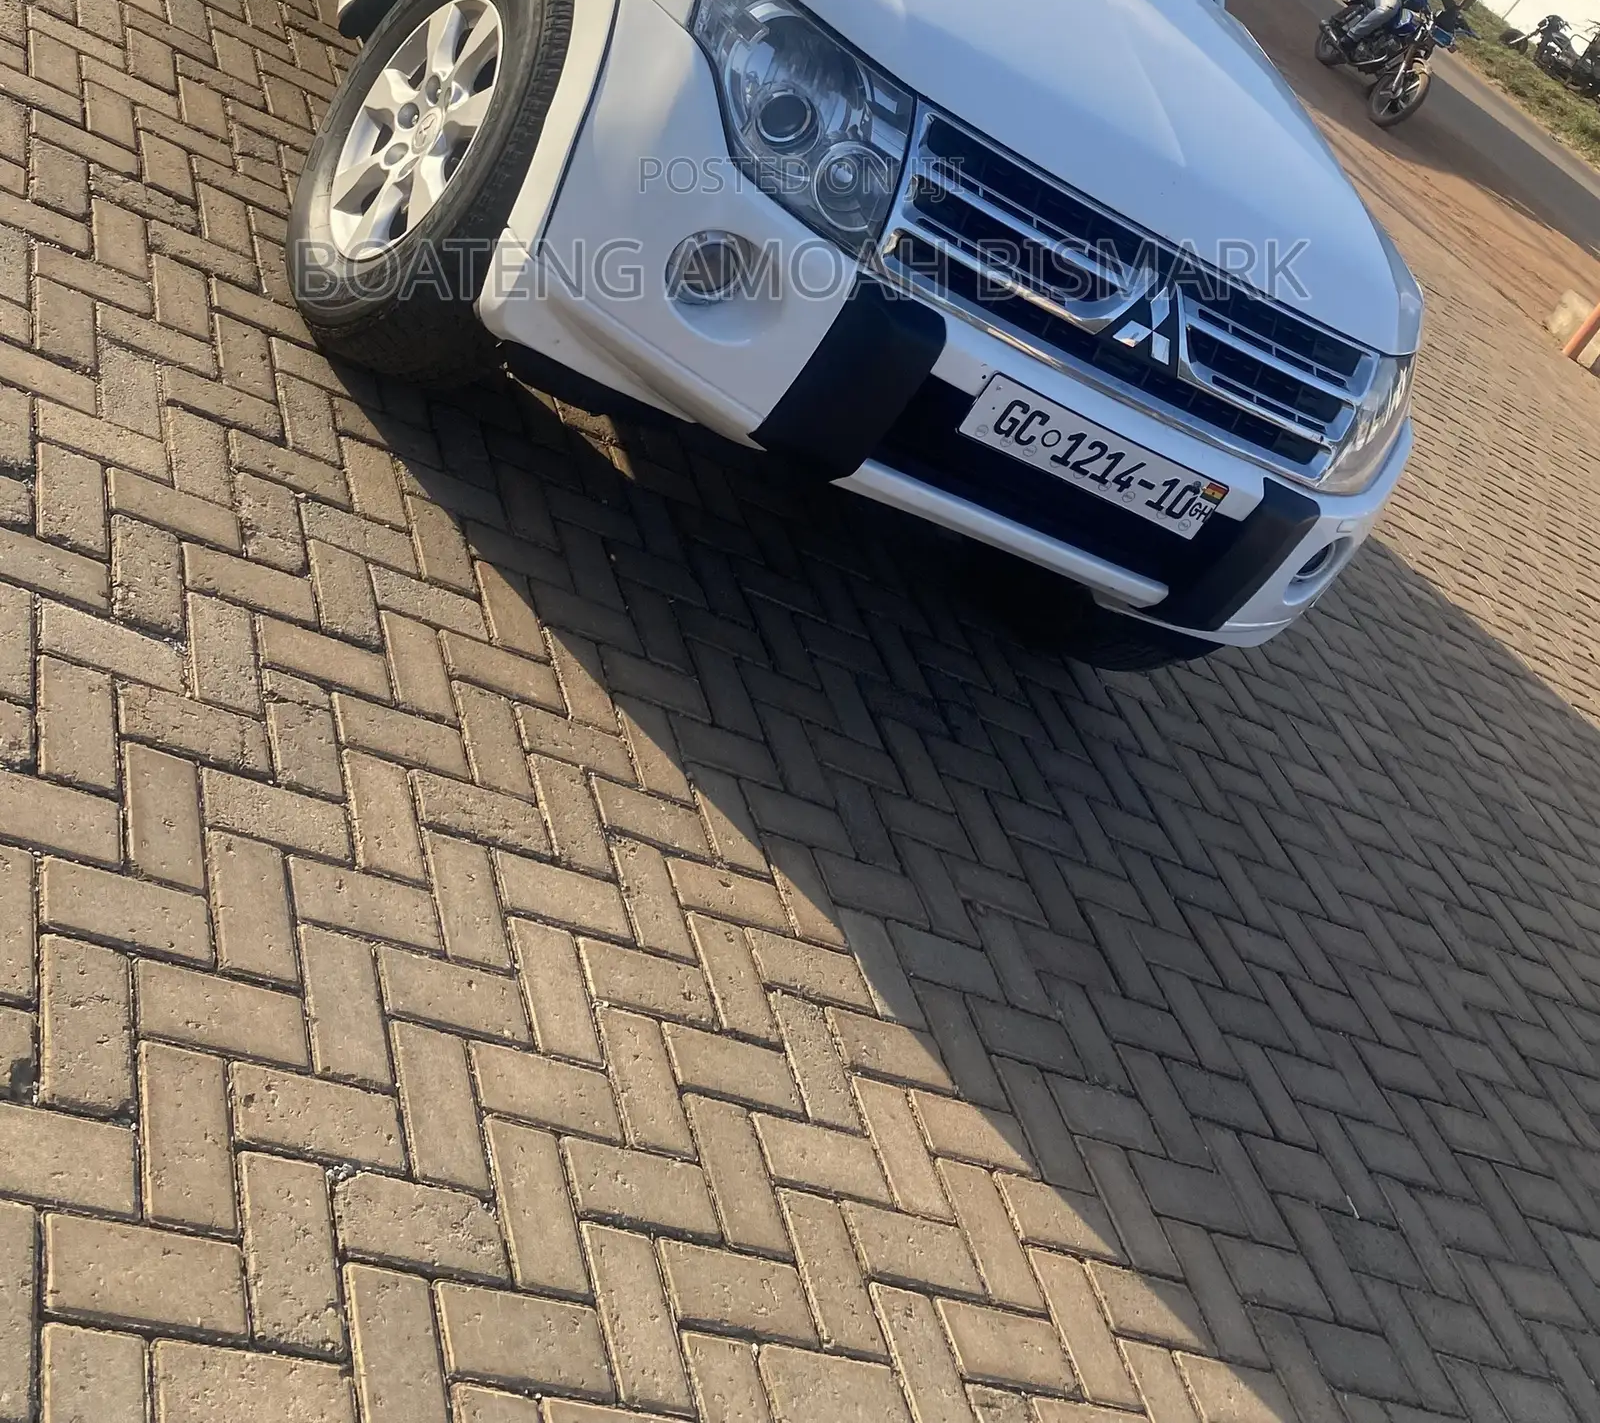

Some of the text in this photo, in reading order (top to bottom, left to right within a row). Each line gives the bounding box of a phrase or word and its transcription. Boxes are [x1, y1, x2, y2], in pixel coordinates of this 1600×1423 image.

[993, 399, 1200, 520] GC 1214-10
[1188, 502, 1213, 524] GH
